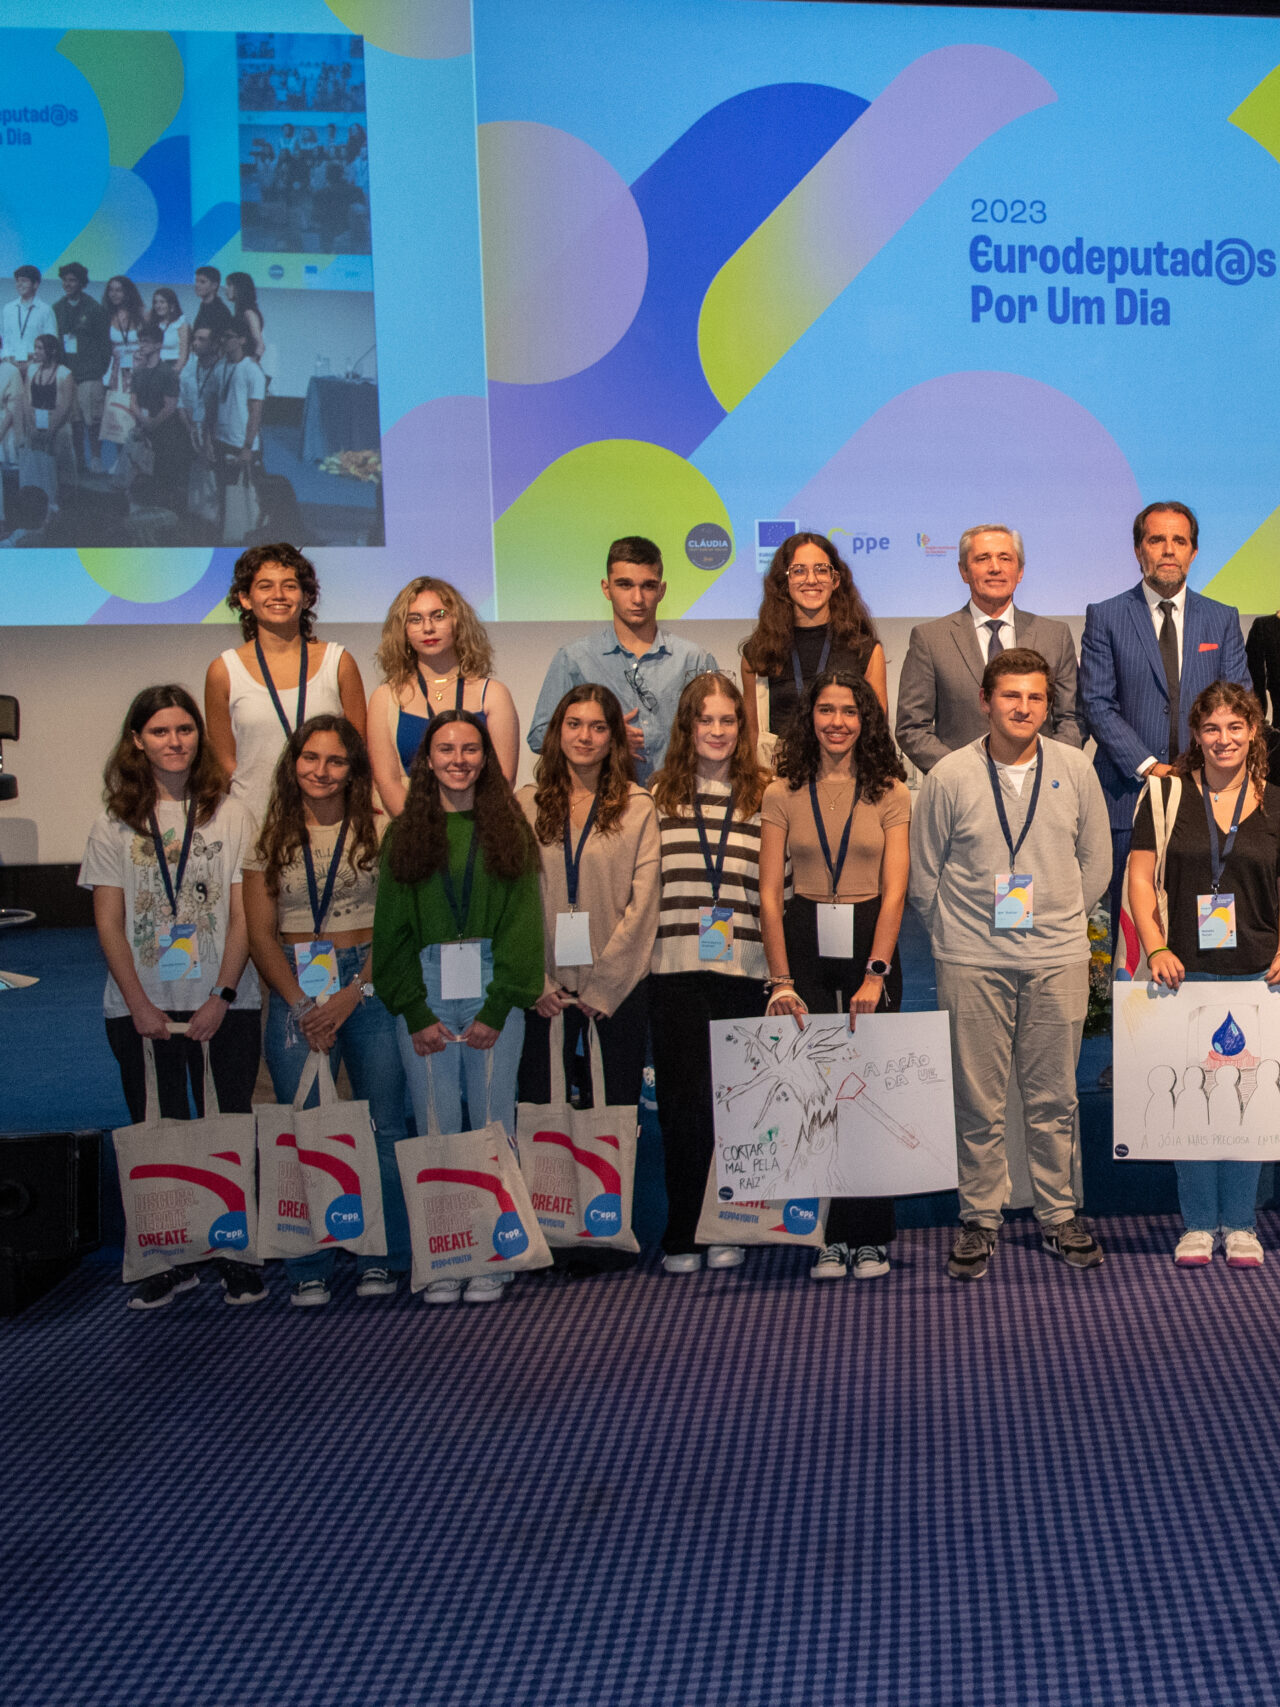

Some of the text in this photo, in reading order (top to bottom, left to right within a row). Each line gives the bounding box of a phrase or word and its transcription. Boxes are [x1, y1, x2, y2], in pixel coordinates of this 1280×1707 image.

[0, 104, 78, 127] putad@s
[7, 128, 32, 145] Dia
[971, 198, 1047, 224] 2023
[971, 285, 1171, 326] Por Um Dia
[688, 538, 729, 548] CLÁUDIA
[852, 537, 890, 554] ppe
[863, 1052, 930, 1077] A AÇÃO
[885, 1068, 938, 1091] DA UE
[770, 1142, 777, 1155] O
[1141, 1134, 1149, 1149] A
[1212, 1134, 1250, 1146] PRECIOSA
[725, 1157, 780, 1174] MAL PELA
[531, 1192, 575, 1215] CREATE.
[342, 1212, 358, 1221] epp
[600, 1212, 616, 1220] epp
[799, 1210, 814, 1219] epp
[138, 1228, 192, 1247] CREATE.
[226, 1229, 242, 1238] epp
[429, 1230, 478, 1253] CREATE.
